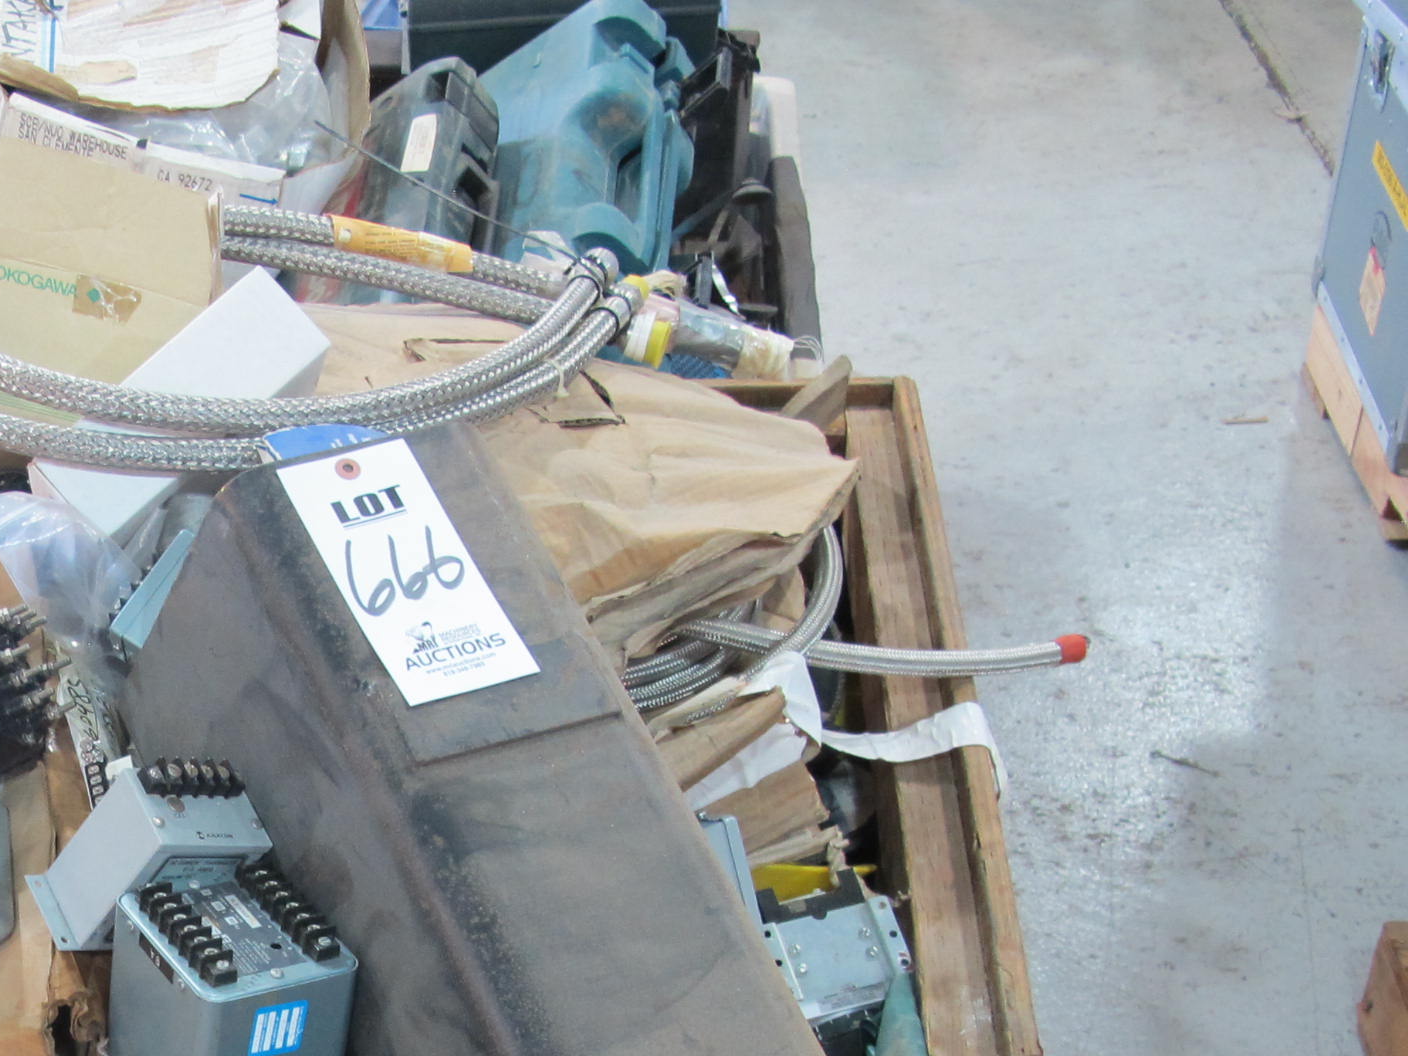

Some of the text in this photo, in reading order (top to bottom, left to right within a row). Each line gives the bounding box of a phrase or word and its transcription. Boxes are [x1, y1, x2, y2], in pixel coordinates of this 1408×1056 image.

[69, 130, 128, 160] WAREHOUSE
[177, 173, 214, 192] 92672
[330, 484, 405, 524] LOT
[344, 525, 465, 617] 666
[405, 632, 507, 671] AUCTIONS
